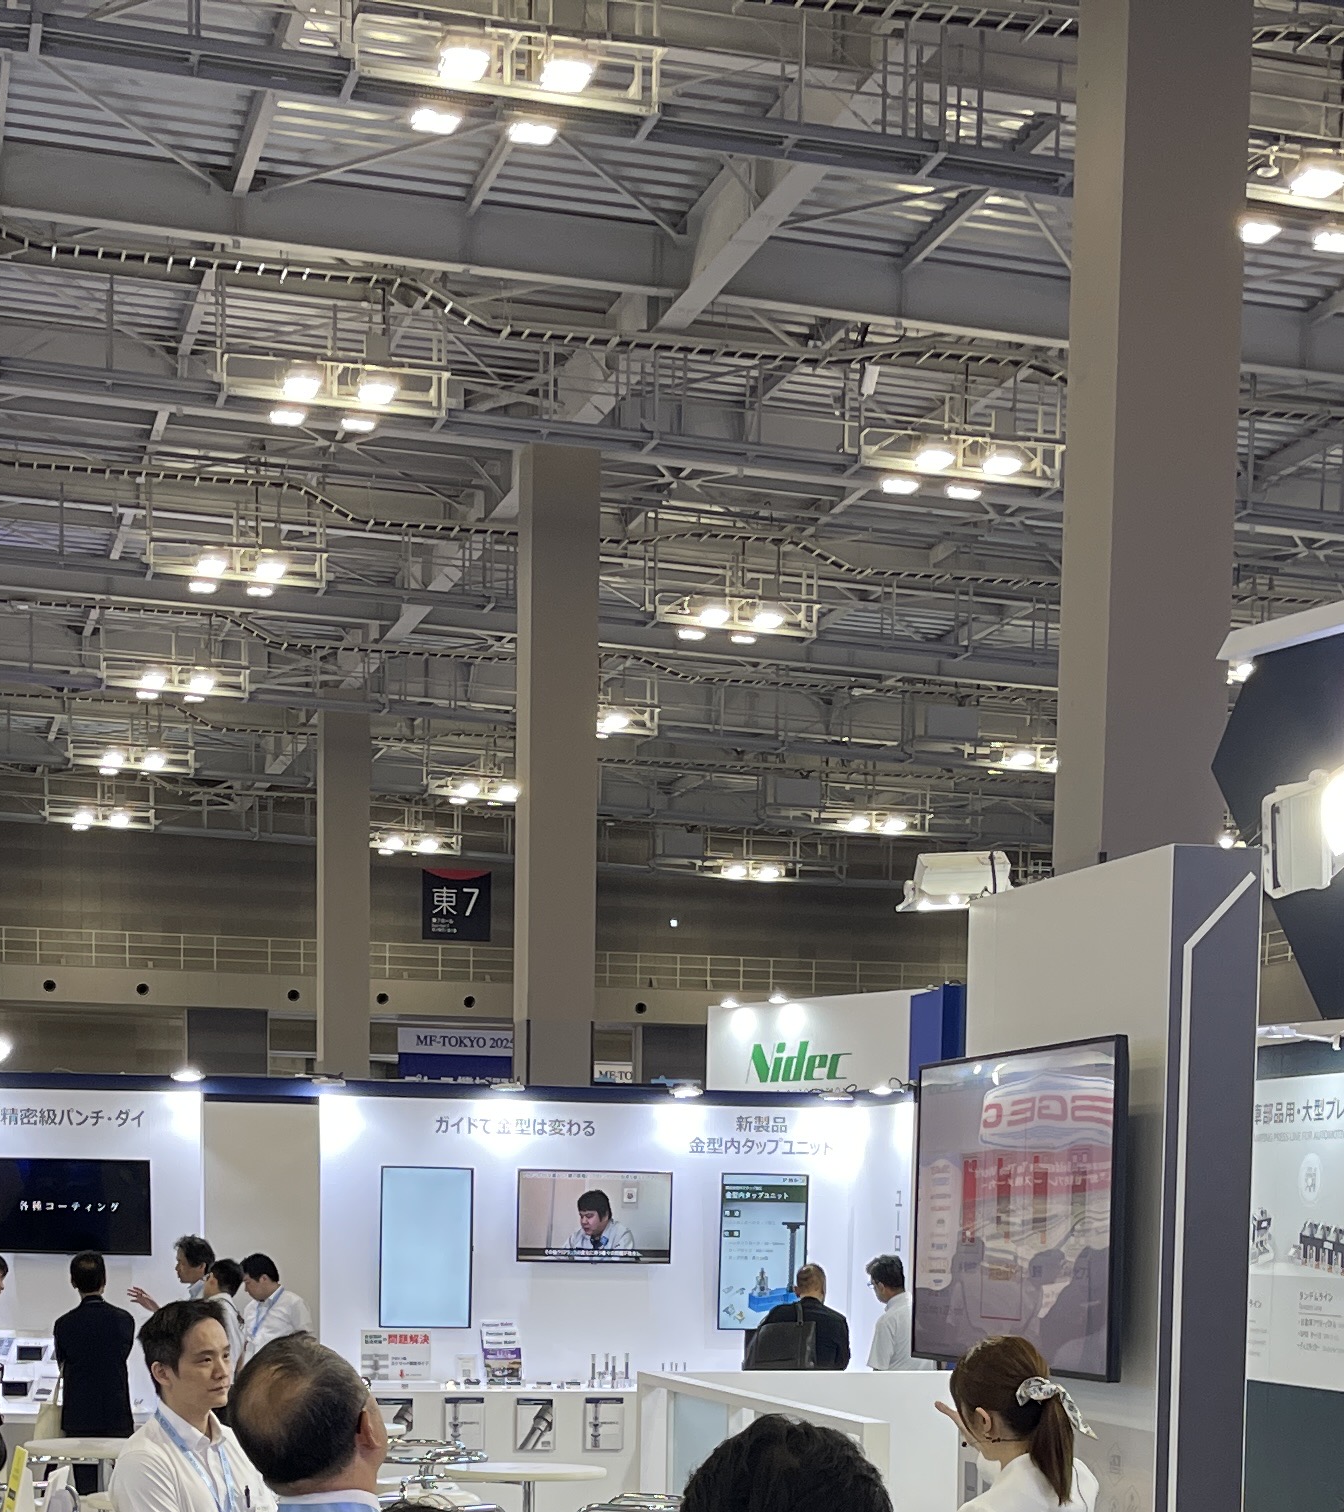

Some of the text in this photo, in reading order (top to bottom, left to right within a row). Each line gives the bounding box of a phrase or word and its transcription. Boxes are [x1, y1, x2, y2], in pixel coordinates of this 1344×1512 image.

[416, 1035, 486, 1049] MF-TOKYO
[746, 1040, 852, 1084] Nidec
[0, 1107, 145, 1128] 精密級パンチ・ダイ
[736, 1115, 788, 1134] 新製品
[689, 1137, 833, 1156] 金型内タップユニット
[19, 1200, 120, 1213] 各種コーティング
